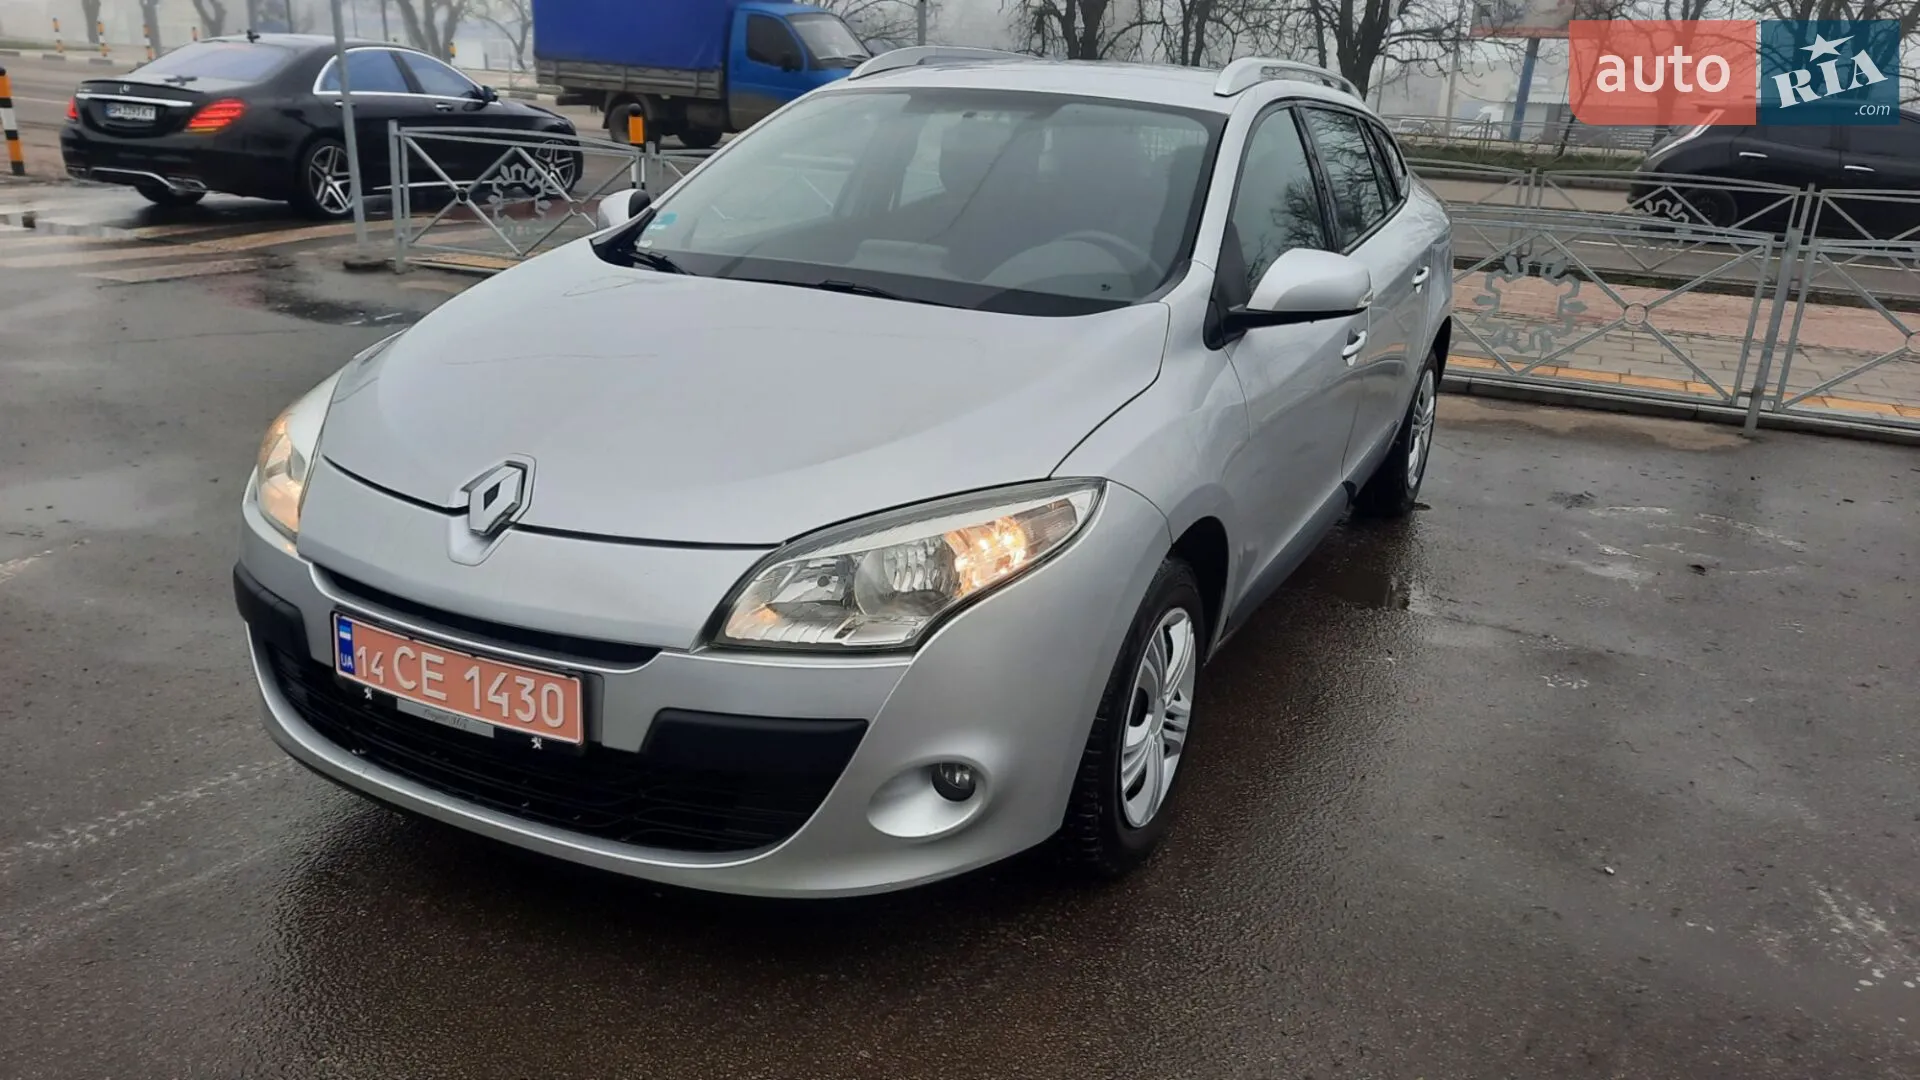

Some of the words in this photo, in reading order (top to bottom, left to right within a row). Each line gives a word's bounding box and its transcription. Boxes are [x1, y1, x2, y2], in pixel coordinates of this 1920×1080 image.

[340, 652, 354, 669] UA
[356, 646, 384, 684] 14
[393, 646, 447, 701] CE
[464, 665, 565, 728] 1430
